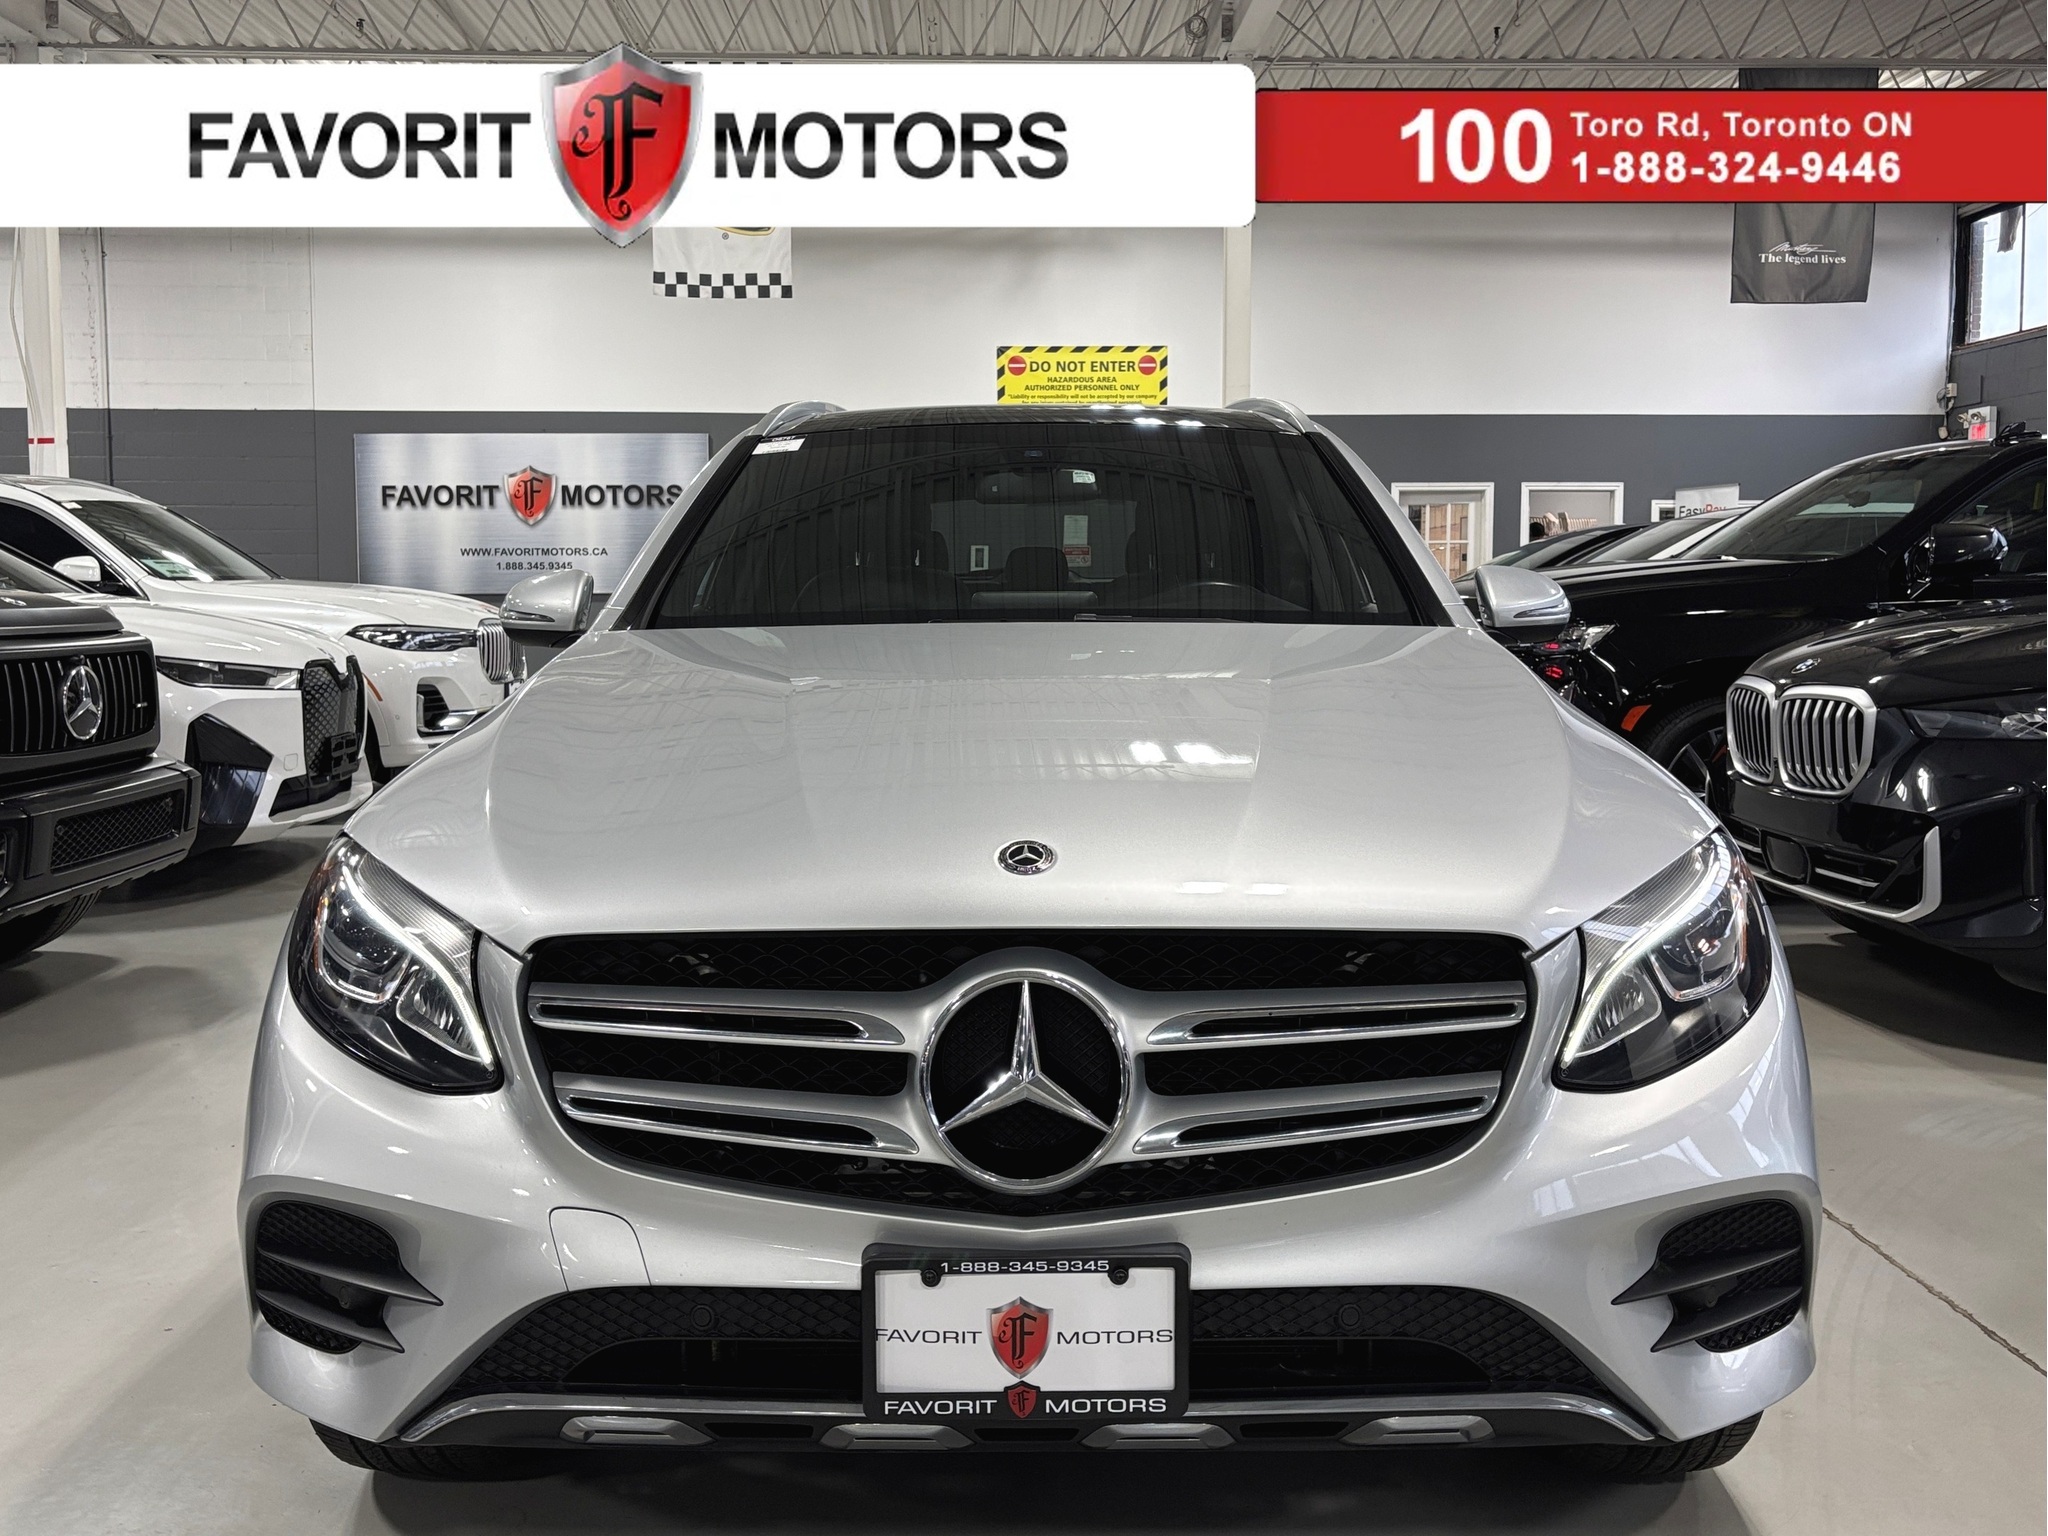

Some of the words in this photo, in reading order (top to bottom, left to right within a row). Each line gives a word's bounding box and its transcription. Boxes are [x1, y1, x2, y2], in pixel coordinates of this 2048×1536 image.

[1759, 253, 1782, 263] The
[1785, 253, 1818, 265] legend
[1821, 254, 1847, 264] lives
[1029, 360, 1052, 373] DO
[1056, 360, 1086, 373] NOT
[1090, 360, 1136, 373] ENTER
[381, 484, 500, 508] FAVORIT
[561, 484, 684, 508] MOTORS
[460, 547, 609, 557] WWW.FAVORITMOTORS.CA
[496, 561, 573, 571] 1.888.345.9345
[940, 1260, 1110, 1273] 1-888-345-9345
[875, 1328, 983, 1344] FAVORIT
[1056, 1328, 1174, 1345] MOTORS
[884, 1400, 998, 1415] FAVORIT
[1045, 1398, 1168, 1414] MOTORS
